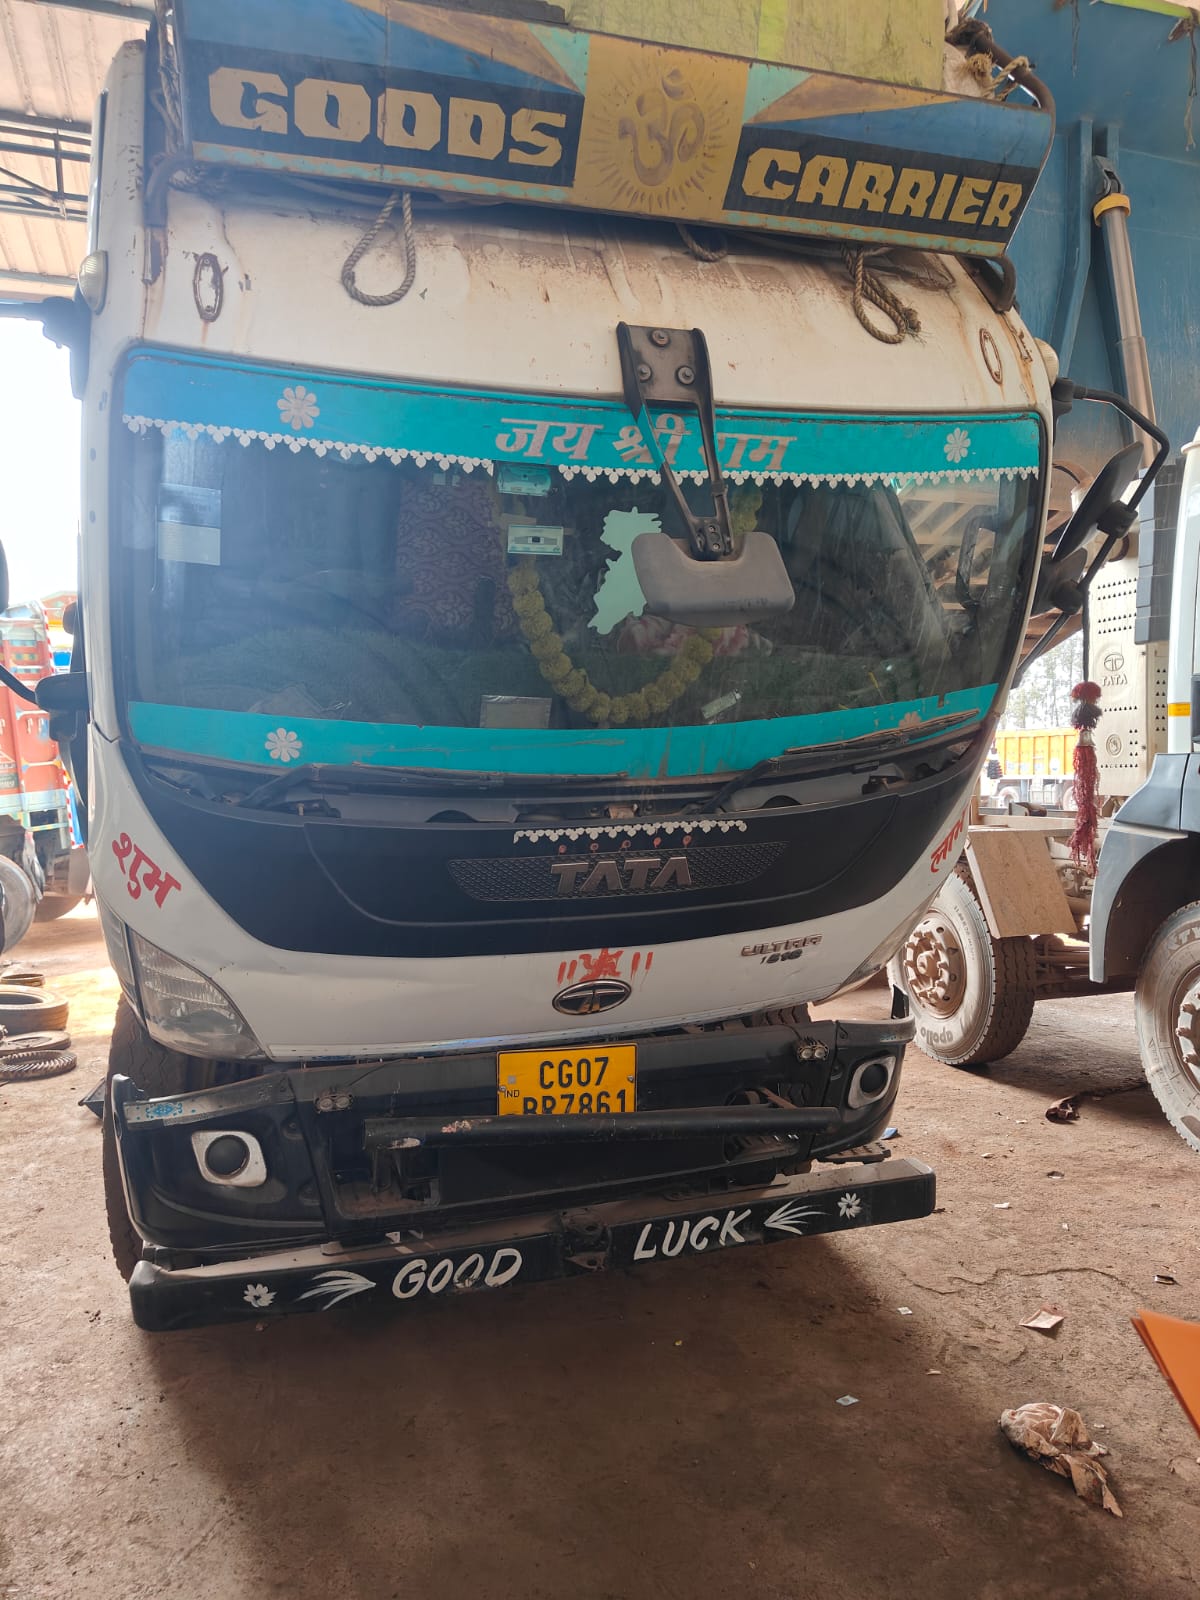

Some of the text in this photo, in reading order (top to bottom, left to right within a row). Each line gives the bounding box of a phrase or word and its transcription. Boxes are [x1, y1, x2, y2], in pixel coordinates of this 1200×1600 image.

[208, 66, 567, 168] GOODS
[741, 147, 1023, 228] CARRIER
[495, 417, 605, 461] जय
[112, 832, 182, 910] शुभ
[550, 855, 693, 897] TATA
[920, 1027, 954, 1047] apollo
[539, 1056, 609, 1090] CG07
[391, 1208, 752, 1300] GOOD LUCK
